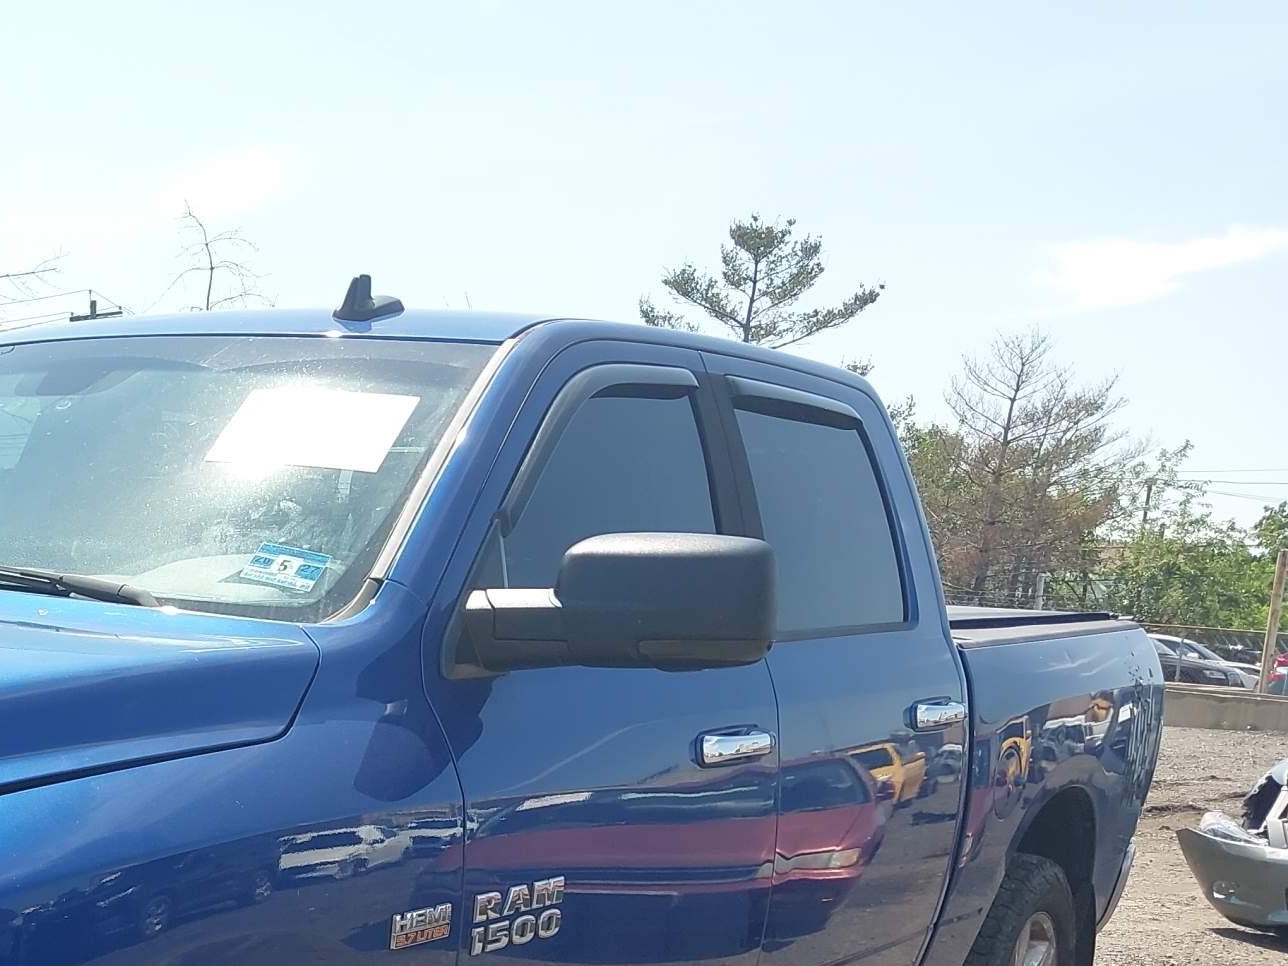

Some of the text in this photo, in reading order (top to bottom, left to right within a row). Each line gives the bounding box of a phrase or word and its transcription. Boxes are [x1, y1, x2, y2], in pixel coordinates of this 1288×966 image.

[277, 559, 292, 572] 5
[392, 903, 452, 934] HEMI
[472, 875, 566, 923] RAM
[470, 908, 563, 957] 1500
